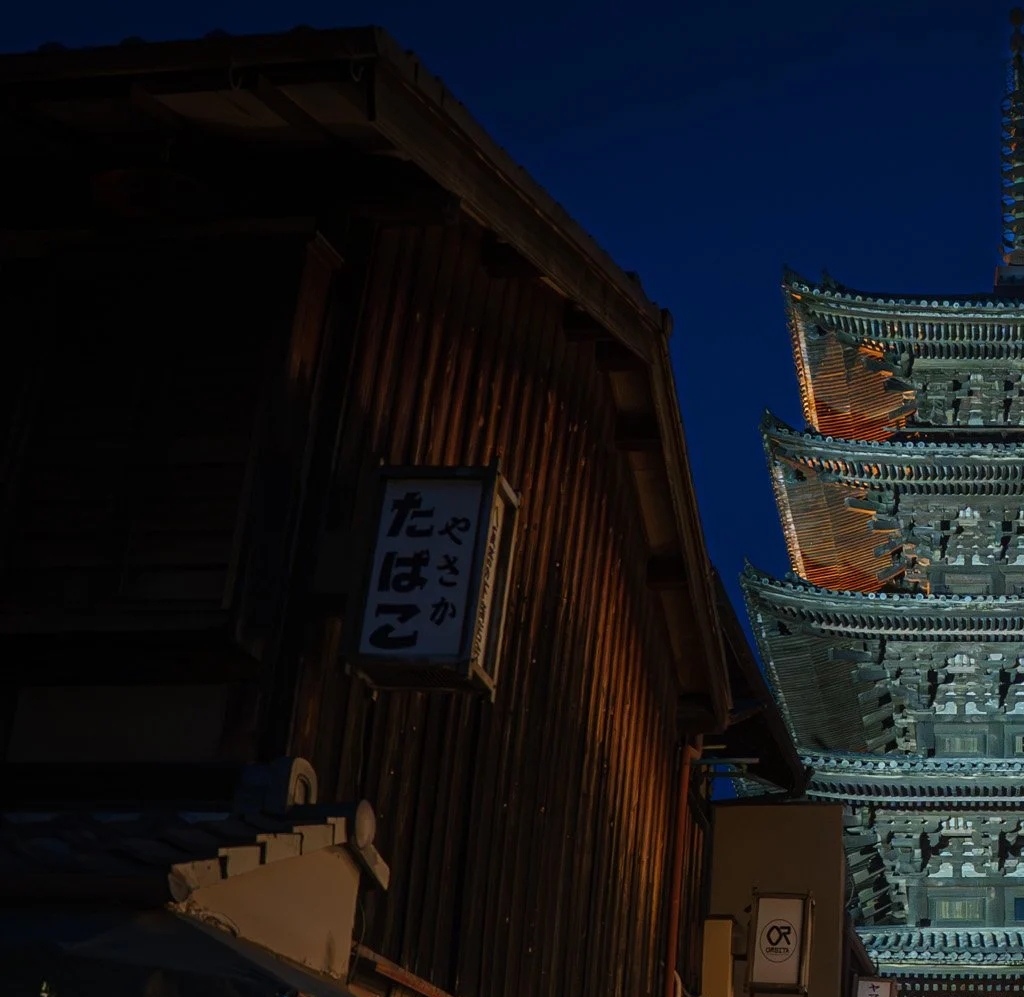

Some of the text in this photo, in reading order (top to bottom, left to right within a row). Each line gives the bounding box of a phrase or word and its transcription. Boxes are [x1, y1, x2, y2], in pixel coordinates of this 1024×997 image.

[368, 491, 436, 650] たばこ
[429, 516, 471, 626] やさか
